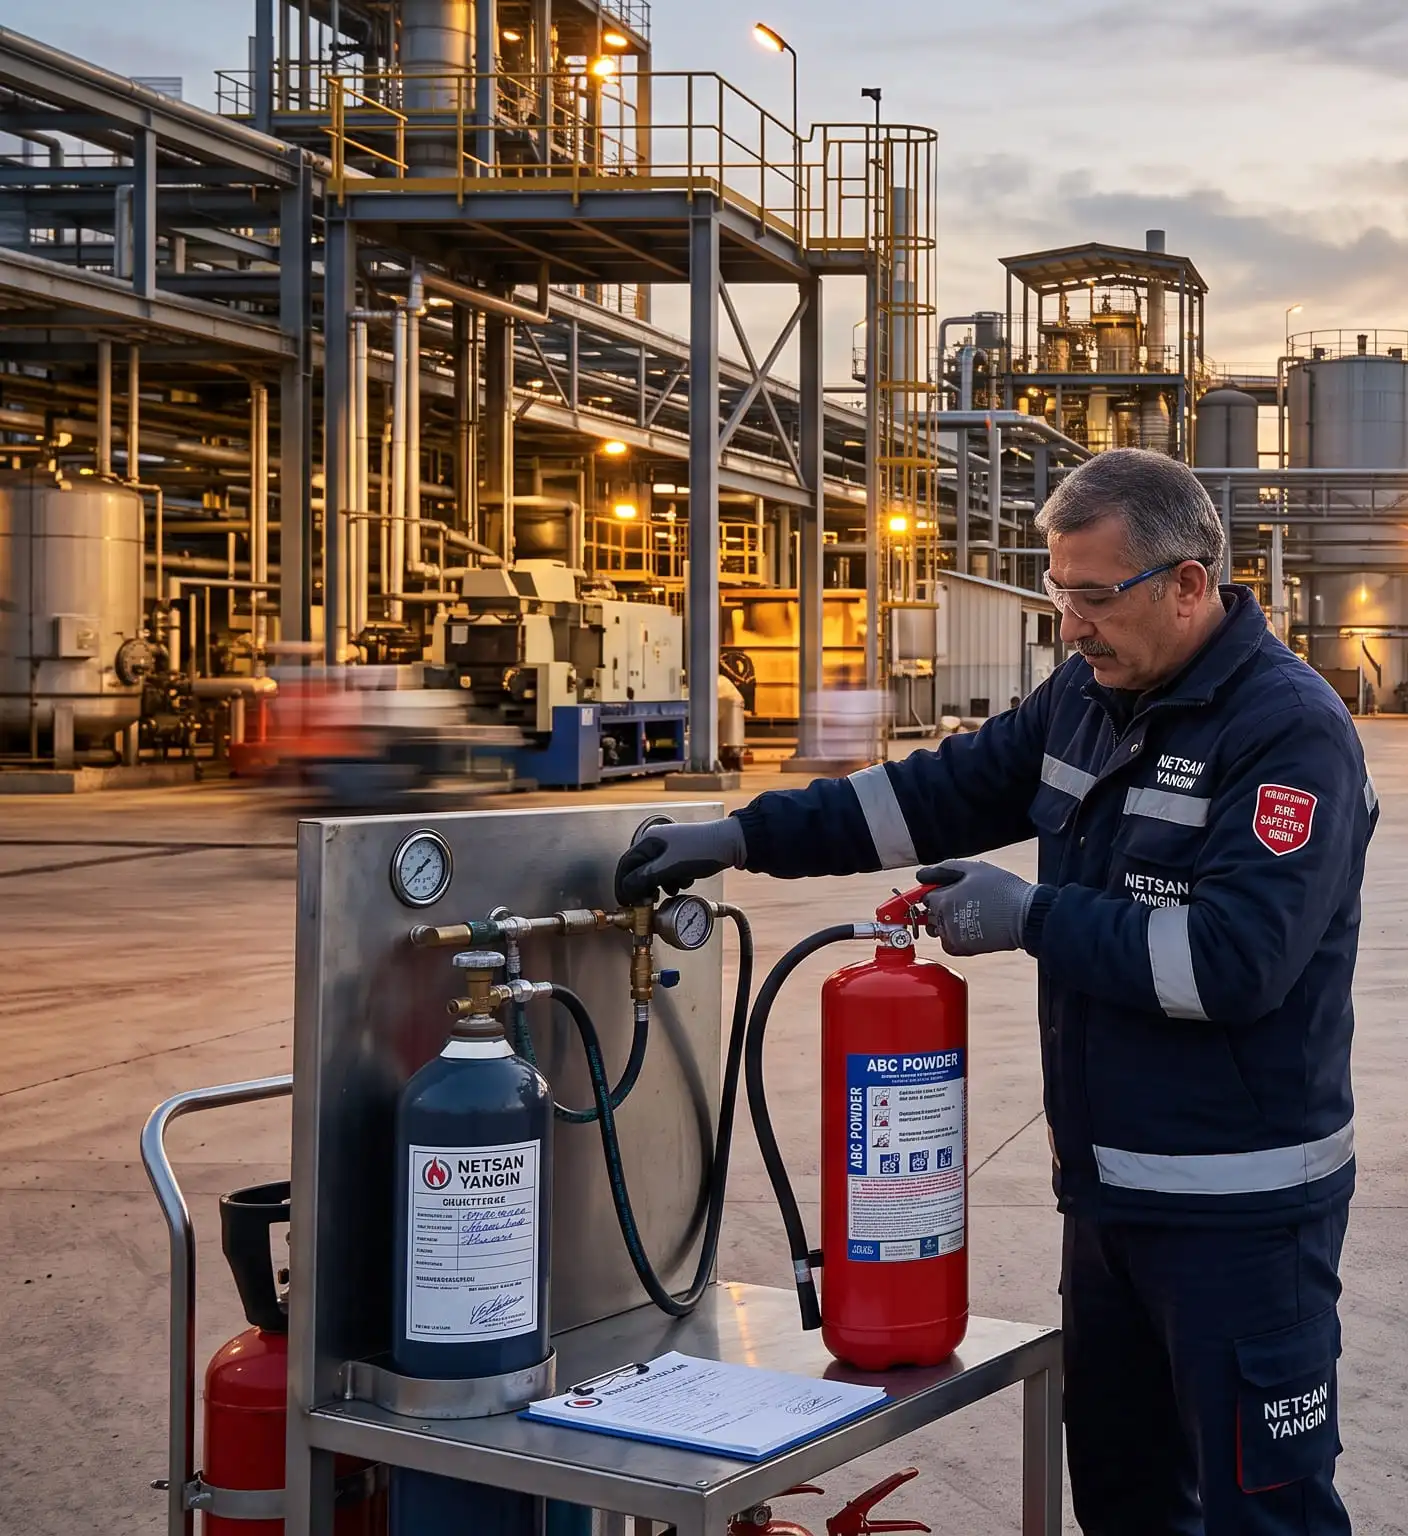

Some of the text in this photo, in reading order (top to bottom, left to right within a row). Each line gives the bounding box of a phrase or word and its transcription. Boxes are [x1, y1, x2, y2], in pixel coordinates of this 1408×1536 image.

[1156, 754, 1206, 776] NETSAN
[1156, 770, 1197, 790] YANGIN
[1124, 872, 1190, 895] NETSAN
[1131, 891, 1181, 908] YANGIN
[866, 1052, 958, 1073] ABC POWDER
[850, 1087, 863, 1169] ABC POWDER
[458, 1154, 525, 1174] NETSAN
[460, 1171, 521, 1190] YANGIN
[1263, 1381, 1328, 1420] NETSAN
[1267, 1404, 1327, 1440] YANGIN
